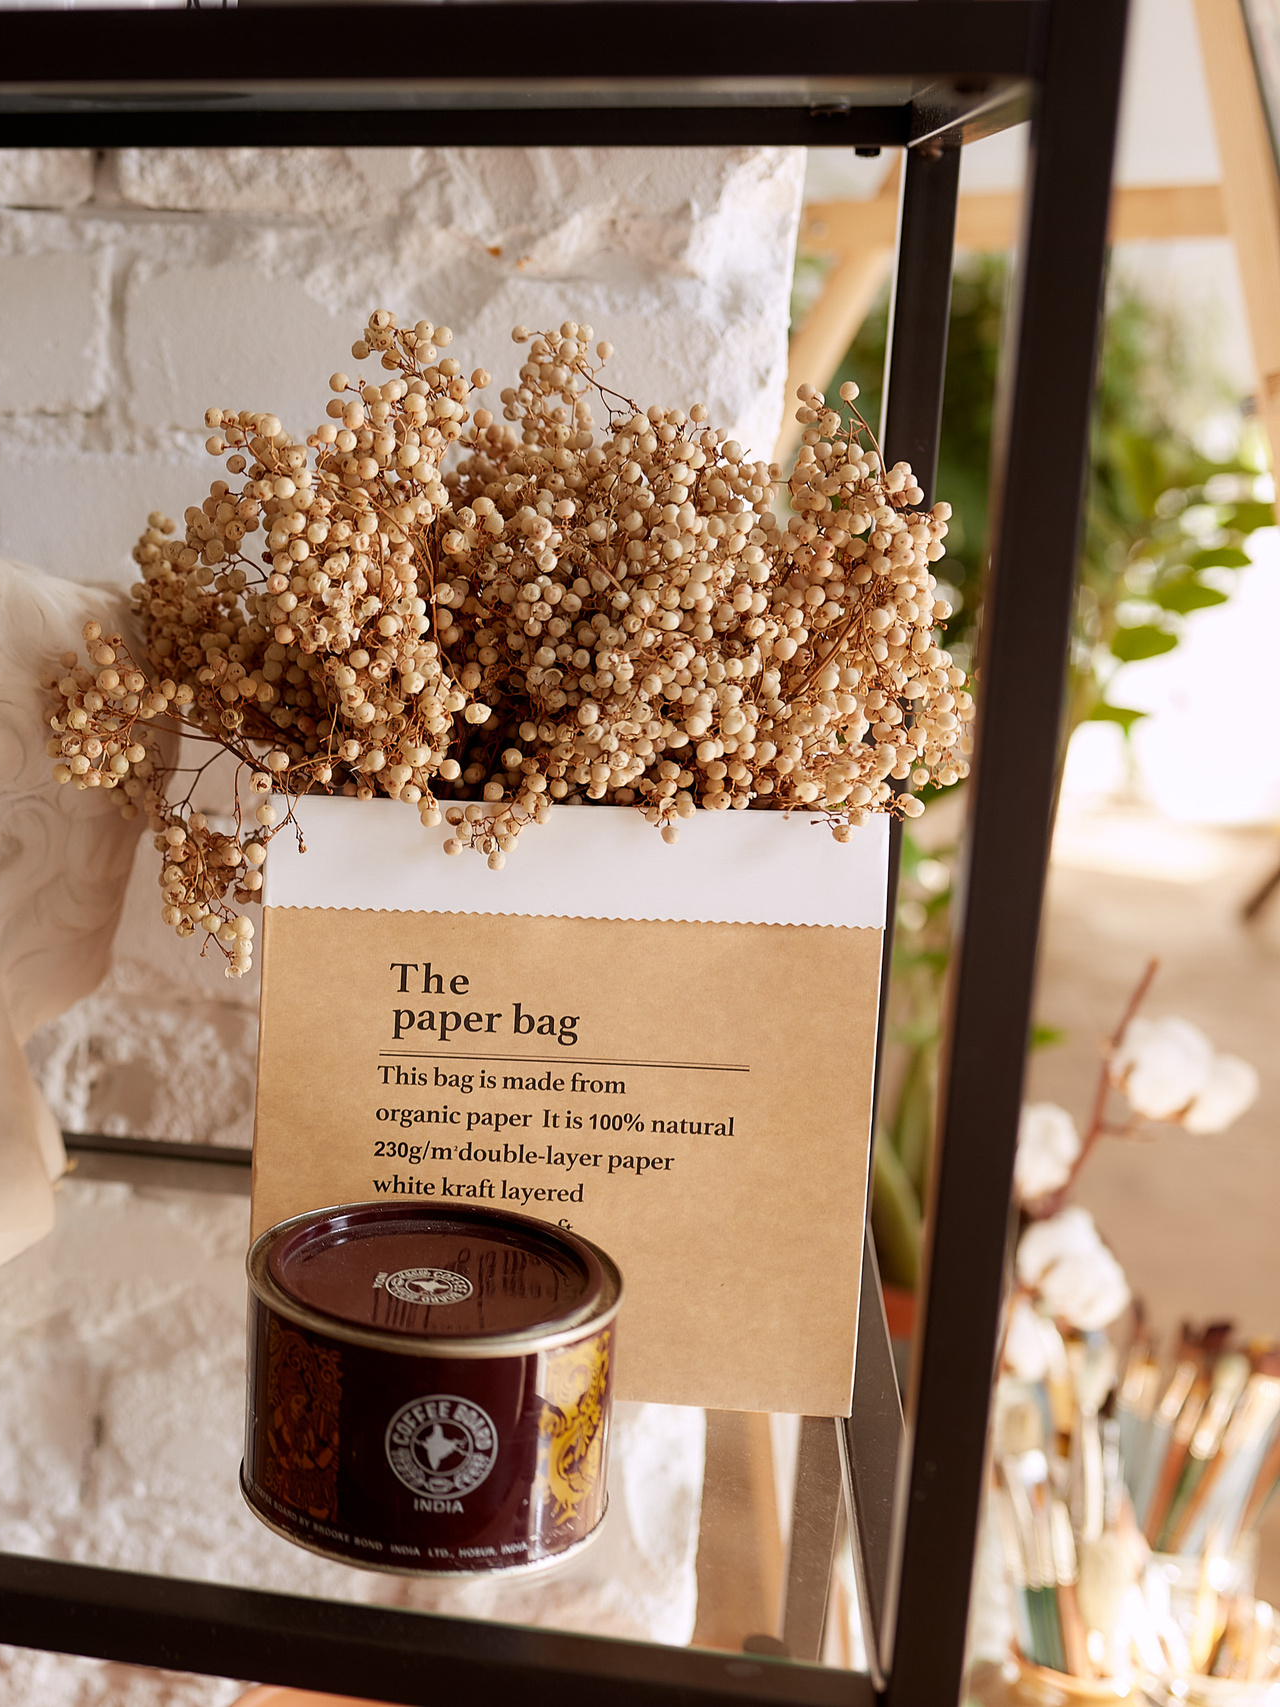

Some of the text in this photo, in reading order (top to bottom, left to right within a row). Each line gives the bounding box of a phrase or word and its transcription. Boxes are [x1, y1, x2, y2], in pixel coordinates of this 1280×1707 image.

[389, 962, 470, 995] The
[392, 1002, 581, 1046] paper bag
[377, 1065, 626, 1095] This bag is made from
[375, 1105, 735, 1137] organic paper It is 100% natural
[607, 1153, 675, 1176] paper
[373, 1174, 584, 1206] white kraft layered
[391, 1400, 452, 1447] COFFEE
[413, 1497, 465, 1514] INDIA
[298, 1514, 310, 1529] BY
[312, 1521, 351, 1544] BROOKE
[353, 1535, 384, 1551] BOND
[389, 1543, 422, 1557] INDIA
